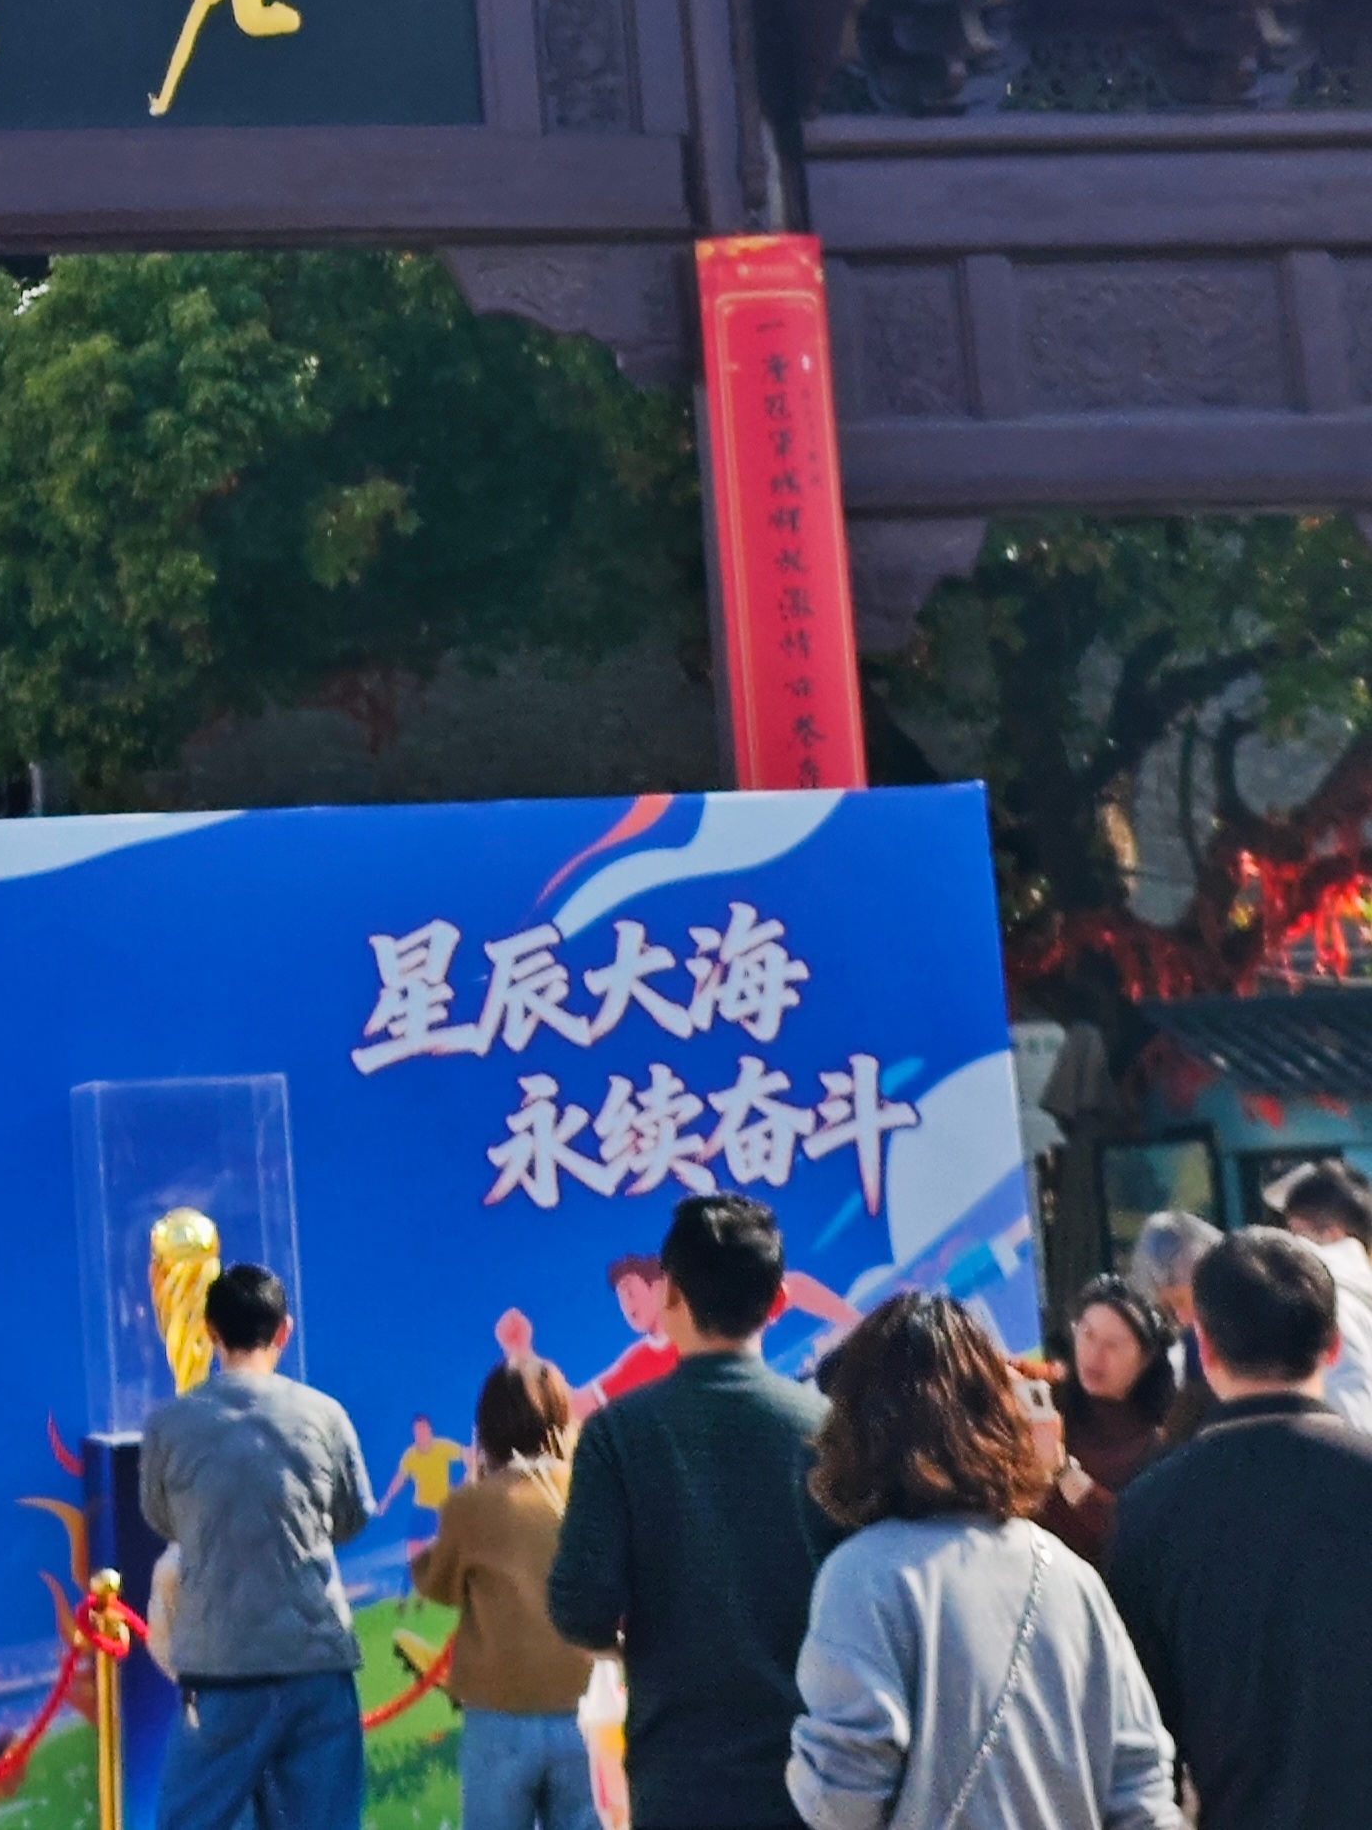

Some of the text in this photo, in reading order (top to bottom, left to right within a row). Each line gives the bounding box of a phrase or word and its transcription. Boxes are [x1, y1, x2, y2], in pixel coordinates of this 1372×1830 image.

[350, 901, 810, 1075] 星辰大海
[483, 1053, 922, 1217] 永续奋斗
